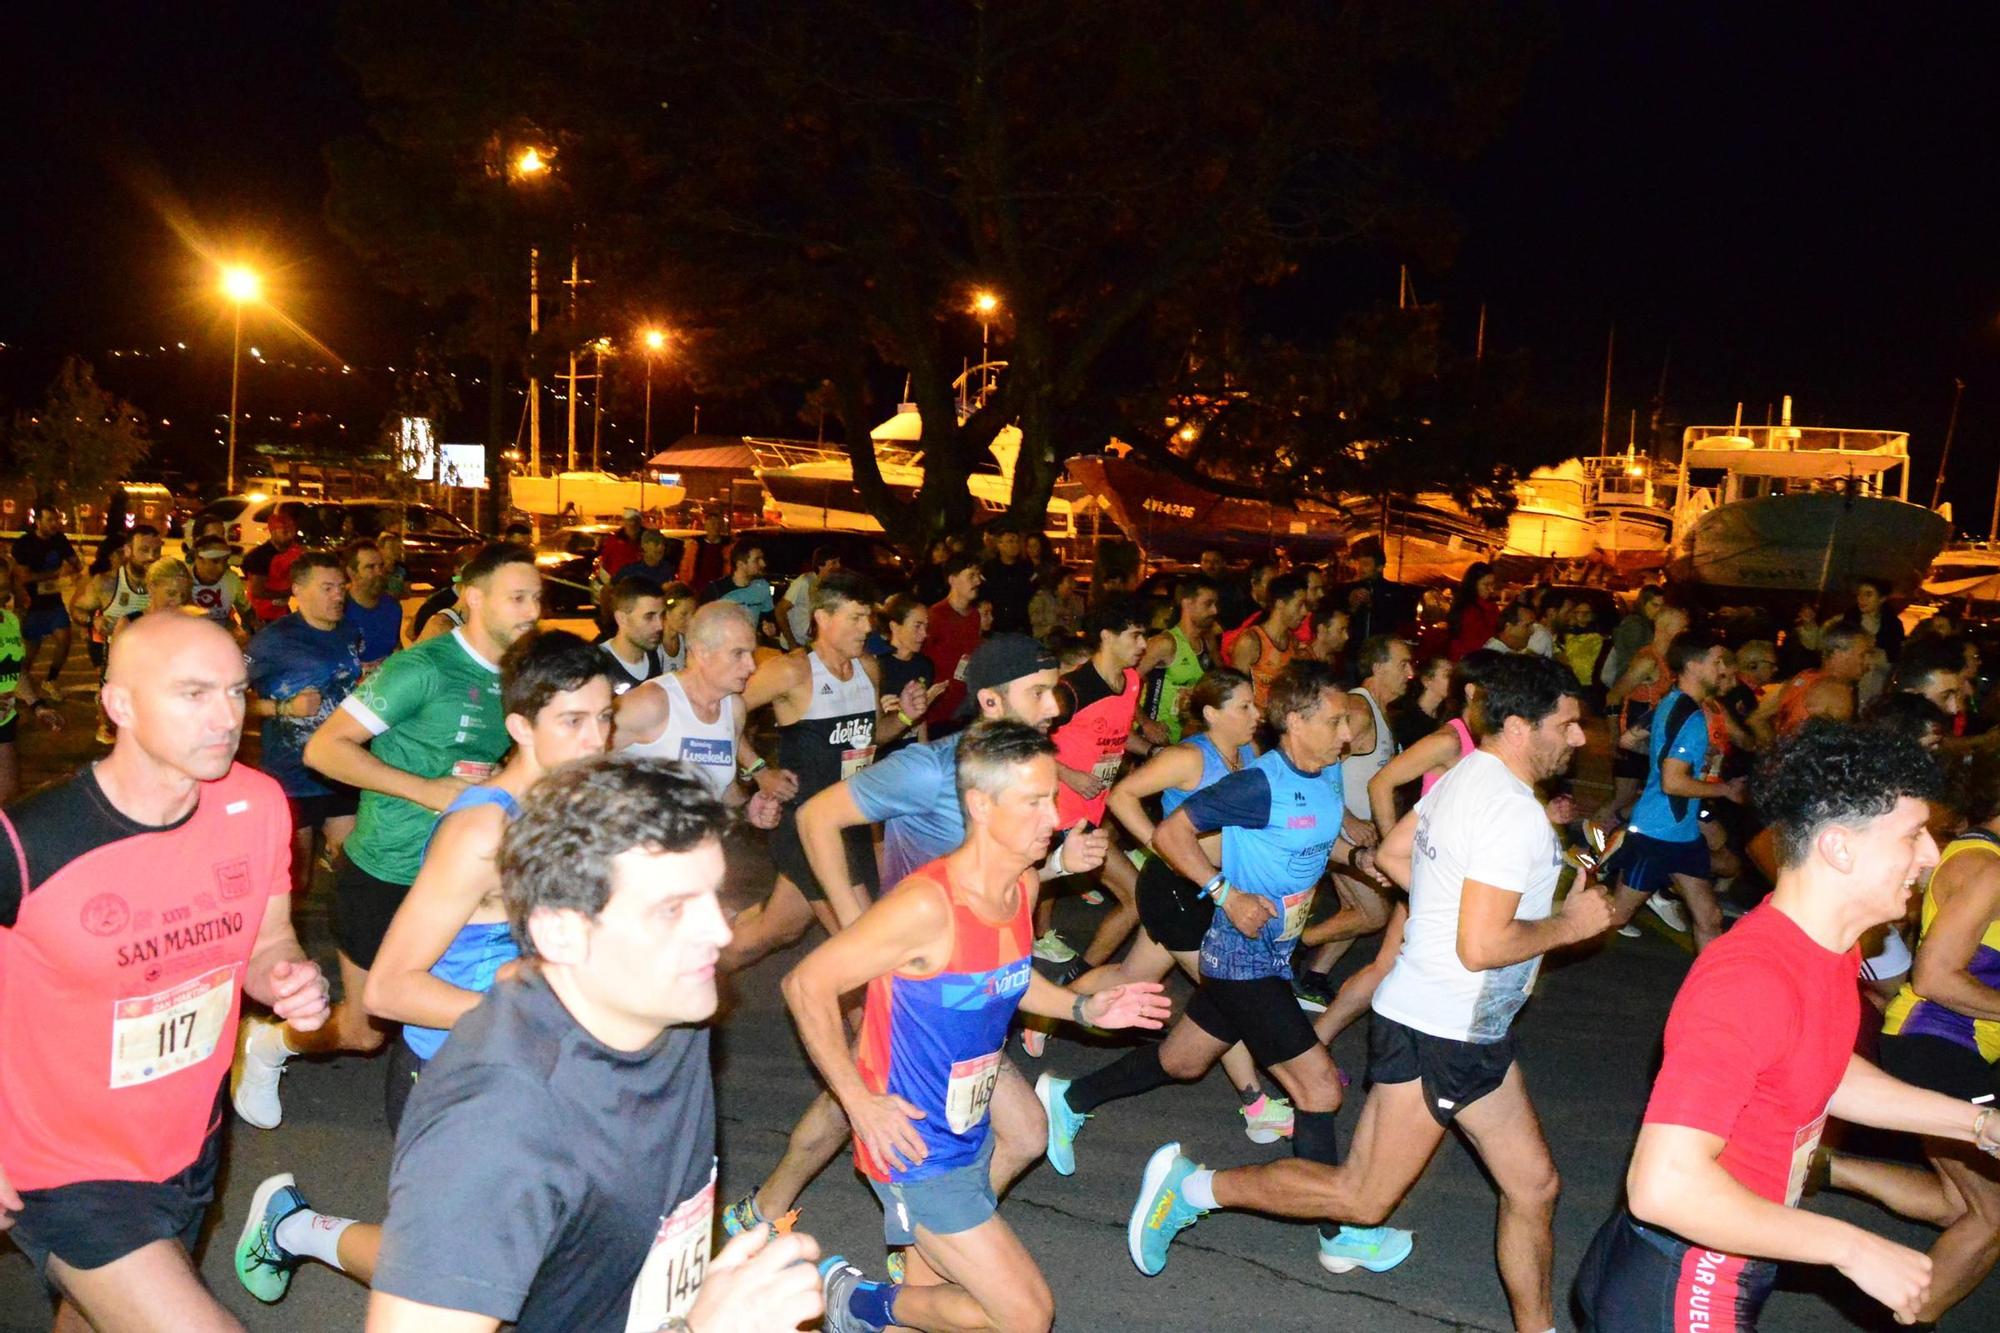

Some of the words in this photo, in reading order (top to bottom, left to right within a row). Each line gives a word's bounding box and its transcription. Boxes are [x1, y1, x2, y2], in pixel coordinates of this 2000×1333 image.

[117, 936, 160, 968] SAN
[163, 911, 243, 954] MARTIÑO
[159, 1010, 198, 1058] 117
